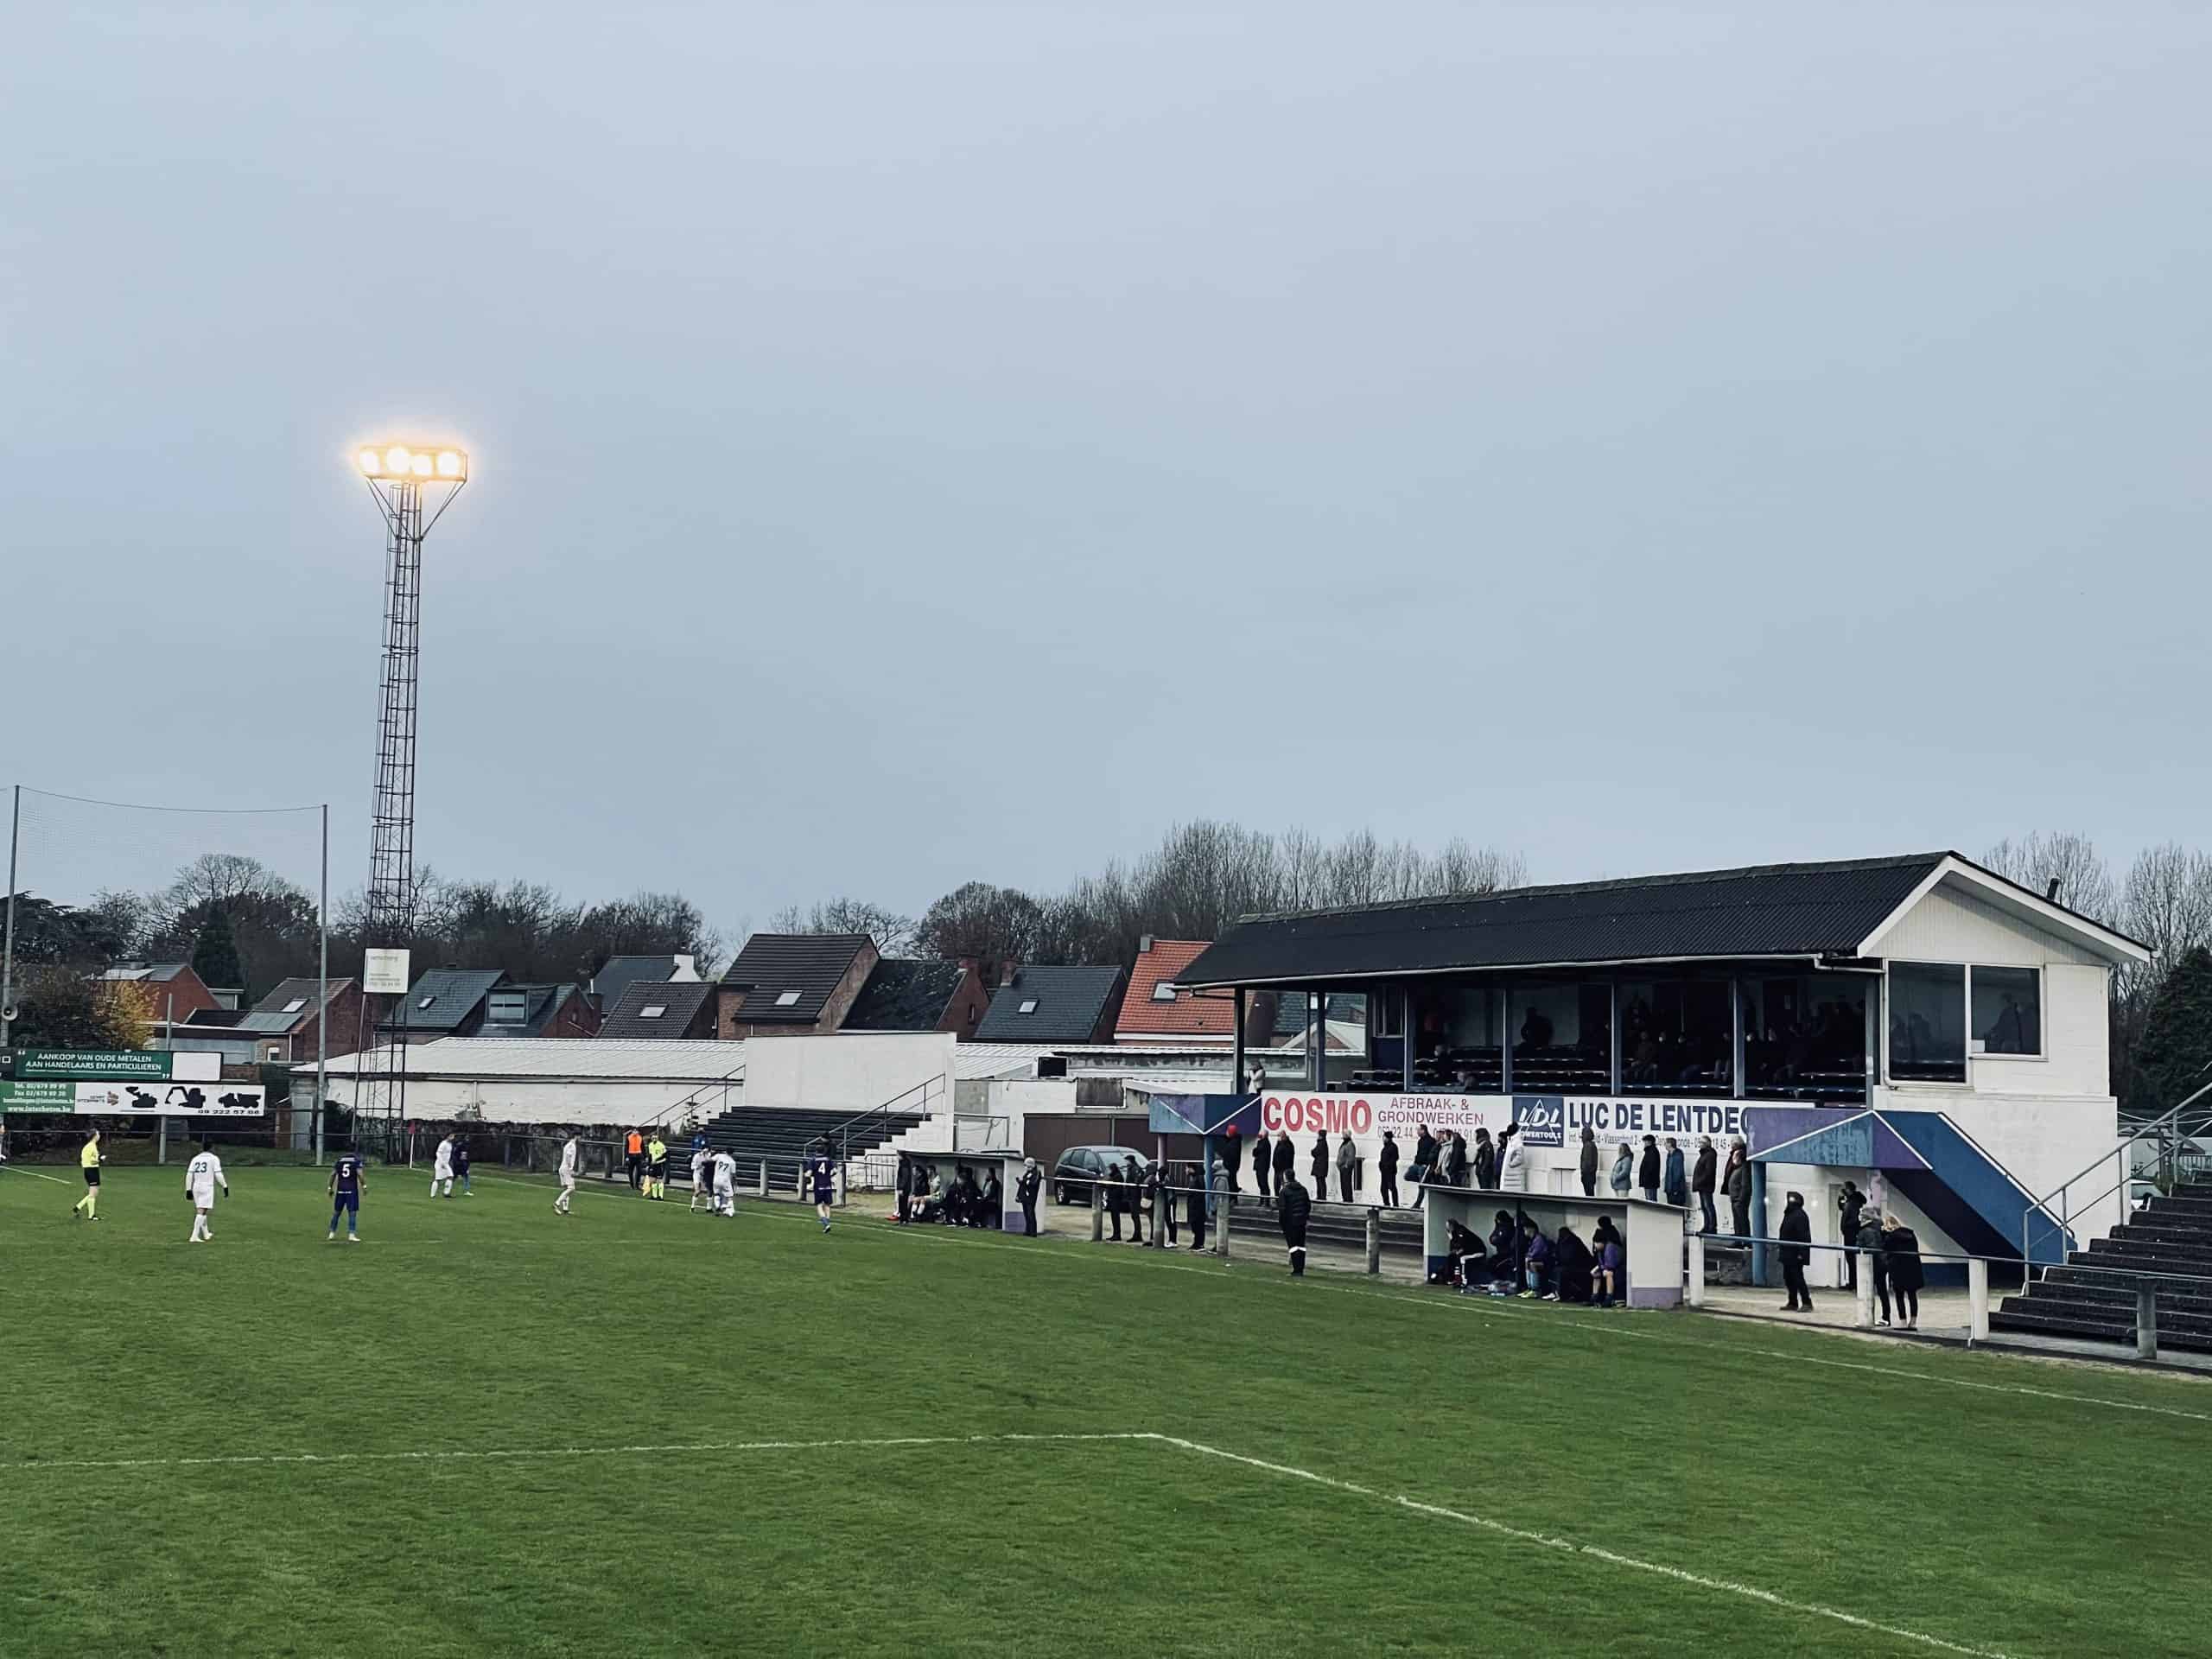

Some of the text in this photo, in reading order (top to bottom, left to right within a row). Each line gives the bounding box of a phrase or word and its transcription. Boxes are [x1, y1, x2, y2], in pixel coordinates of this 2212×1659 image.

[1390, 1097, 1469, 1110] AFBRAAK- &
[1263, 1097, 1372, 1135] COSMO
[1377, 1110, 1484, 1125] GRONDWERKEN
[1569, 1103, 1609, 1129] LUC
[1616, 1104, 1643, 1131] DE
[1519, 1130, 1561, 1139] OWERTOOLS
[194, 1161, 207, 1173] 23
[342, 1163, 350, 1178] 5
[818, 1161, 825, 1174] 4
